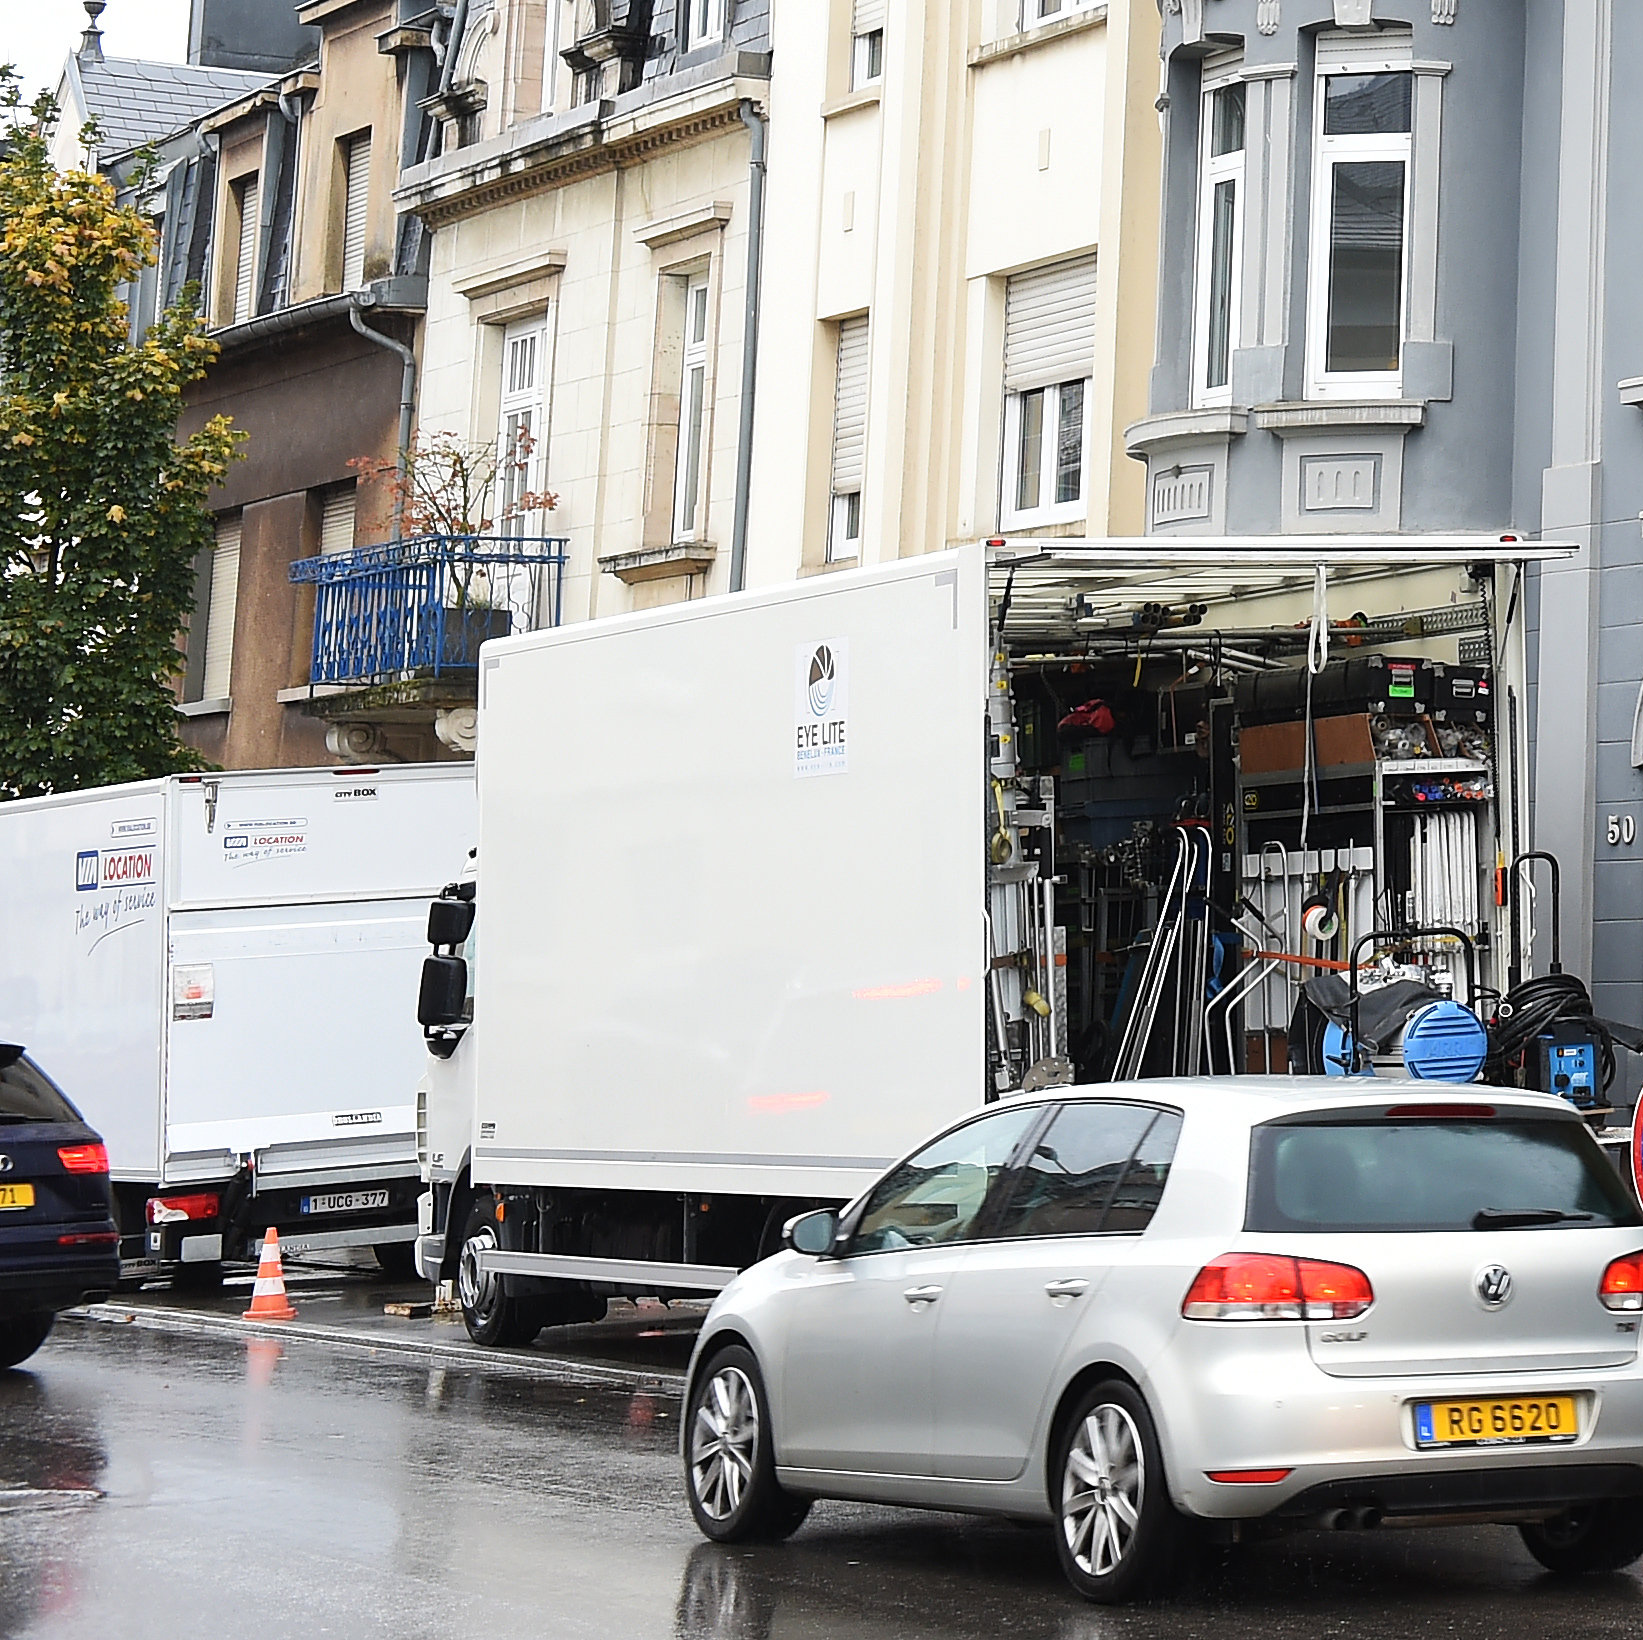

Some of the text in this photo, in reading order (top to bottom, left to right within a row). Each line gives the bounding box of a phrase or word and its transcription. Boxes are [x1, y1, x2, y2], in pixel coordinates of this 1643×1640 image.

[798, 721, 845, 748] EYE LITE
[353, 788, 377, 796] BOX
[1607, 814, 1635, 844] 50
[254, 836, 304, 846] LOCATION
[263, 848, 273, 856] of
[276, 845, 307, 854] service
[103, 853, 153, 881] LOCATION
[75, 887, 155, 935] The way of service
[312, 1191, 387, 1210] 1-UCG-377
[136, 1259, 157, 1267] BOX
[1448, 1403, 1560, 1435] RG 6620
